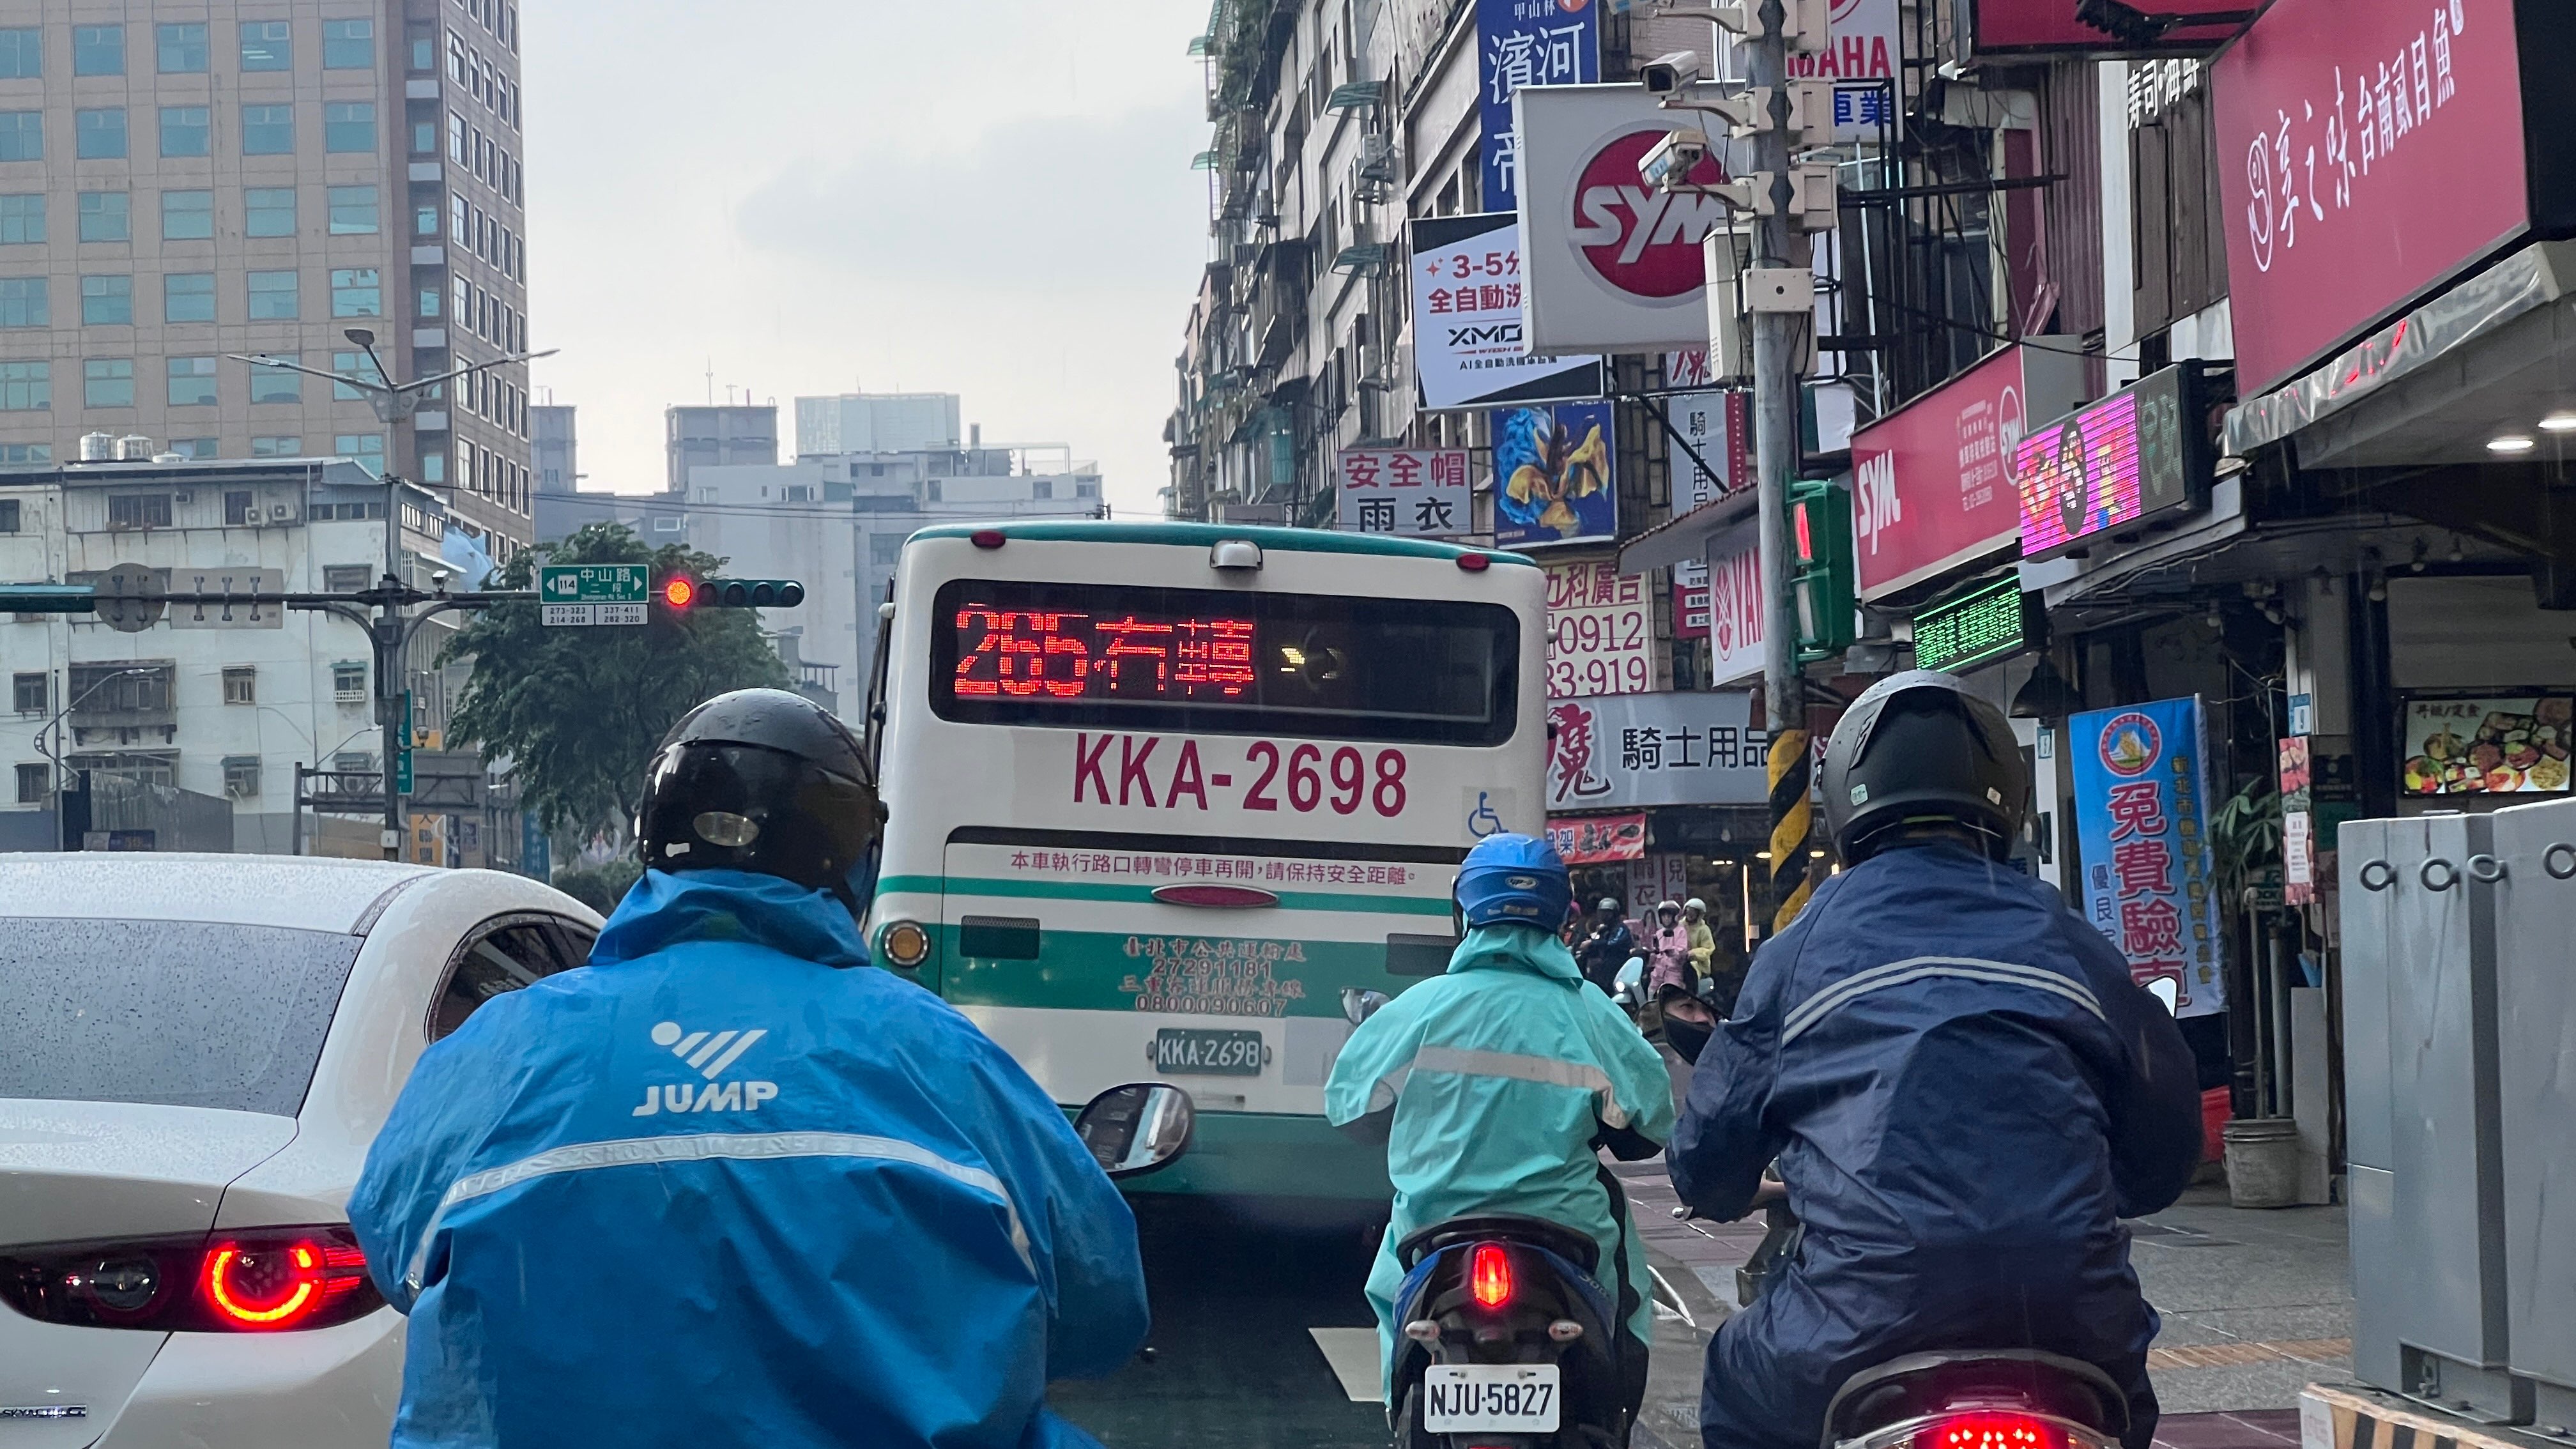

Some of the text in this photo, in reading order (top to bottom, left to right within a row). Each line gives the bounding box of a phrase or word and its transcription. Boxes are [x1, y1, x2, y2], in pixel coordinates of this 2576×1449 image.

[1574, 185, 1728, 264] SYM
[1346, 453, 1466, 489] 安全帽
[1358, 496, 1453, 532] 雨衣
[1859, 449, 1901, 555] SYM
[560, 580, 575, 589] 114
[581, 568, 630, 582] 中山路
[590, 583, 621, 593] 二段
[1558, 611, 1643, 655] 0912
[1622, 726, 1768, 770] 騎士用品
[1074, 733, 1406, 818] KKA-2698
[1152, 958, 1271, 979] 27291181
[1135, 994, 1287, 1017] 0800090607
[632, 1081, 778, 1117] JUMP
